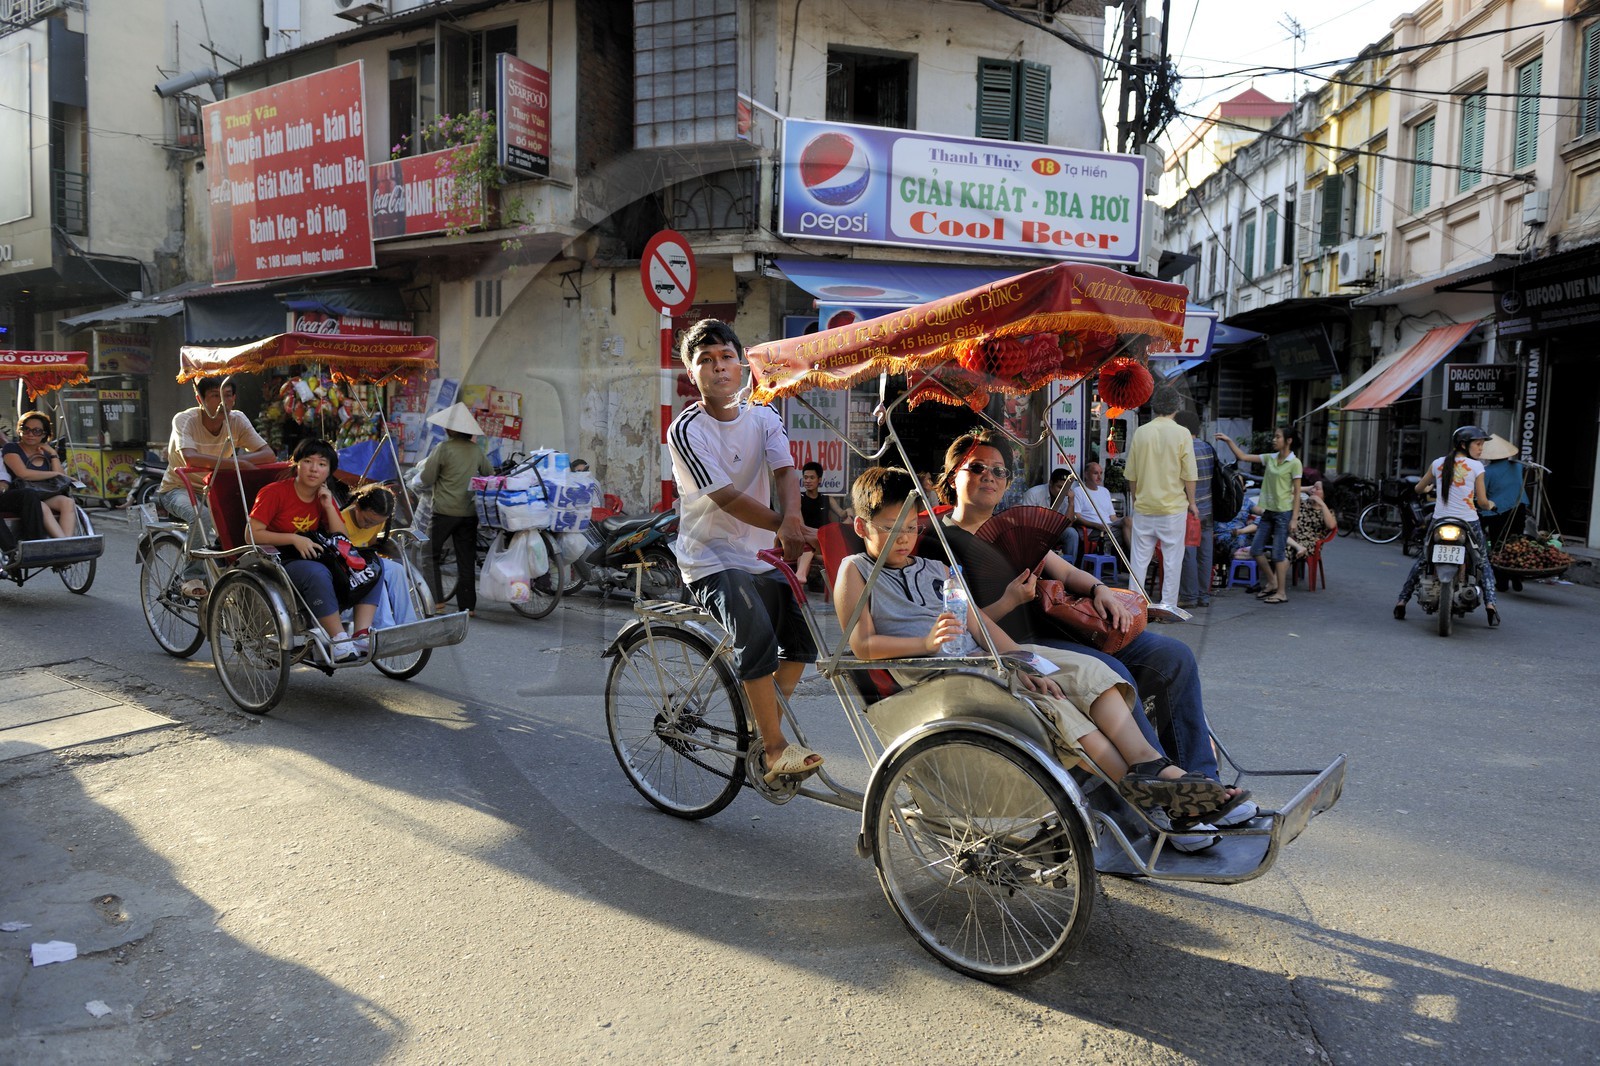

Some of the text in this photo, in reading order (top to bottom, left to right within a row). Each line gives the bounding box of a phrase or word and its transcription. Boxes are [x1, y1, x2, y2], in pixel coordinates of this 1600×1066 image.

[508, 79, 548, 109] STARFOOD
[255, 104, 277, 121] Vân
[226, 131, 262, 166] Chuyên
[263, 126, 284, 157] bán
[285, 118, 314, 151] buôn
[323, 110, 347, 143] bán
[349, 101, 361, 137] lẻ
[929, 147, 978, 165] Thanh
[1038, 159, 1055, 174] 18
[1064, 163, 1078, 177] Tạ
[231, 178, 255, 206] Nước
[257, 170, 277, 200] Giải
[279, 167, 304, 196] Khát
[313, 161, 343, 193] Rượu
[345, 154, 366, 185] Bia
[405, 174, 433, 217] BÁNH
[901, 168, 953, 207] GIẢI
[960, 177, 1027, 213] KHÁT
[1045, 190, 1084, 219] BIA
[1090, 194, 1130, 223] HƠI
[250, 213, 276, 244] Bánh
[276, 214, 298, 245] Kẹo
[306, 203, 322, 236] Đồ
[324, 203, 347, 238] Hộp
[800, 211, 869, 234] pepsi
[909, 211, 1119, 250] Cool Beer
[268, 254, 281, 269] 18B
[302, 250, 320, 266] Ngọc
[1525, 284, 1563, 307] EUFOOD
[1563, 278, 1586, 300] VIET
[829, 352, 858, 368] Hàng
[900, 337, 915, 350] 15
[917, 332, 951, 347] Hàng
[954, 319, 985, 339] Giấy
[20, 354, 68, 363] GƯƠM
[1450, 369, 1501, 381] DRAGONFLY
[1454, 382, 1470, 391] BAR
[1477, 382, 1496, 391] CLUB
[1521, 348, 1540, 462] EUFOOD VIET NAM
[1056, 418, 1077, 431] Mirinda
[789, 438, 843, 472] BIA HƠI
[1058, 435, 1075, 448] Water
